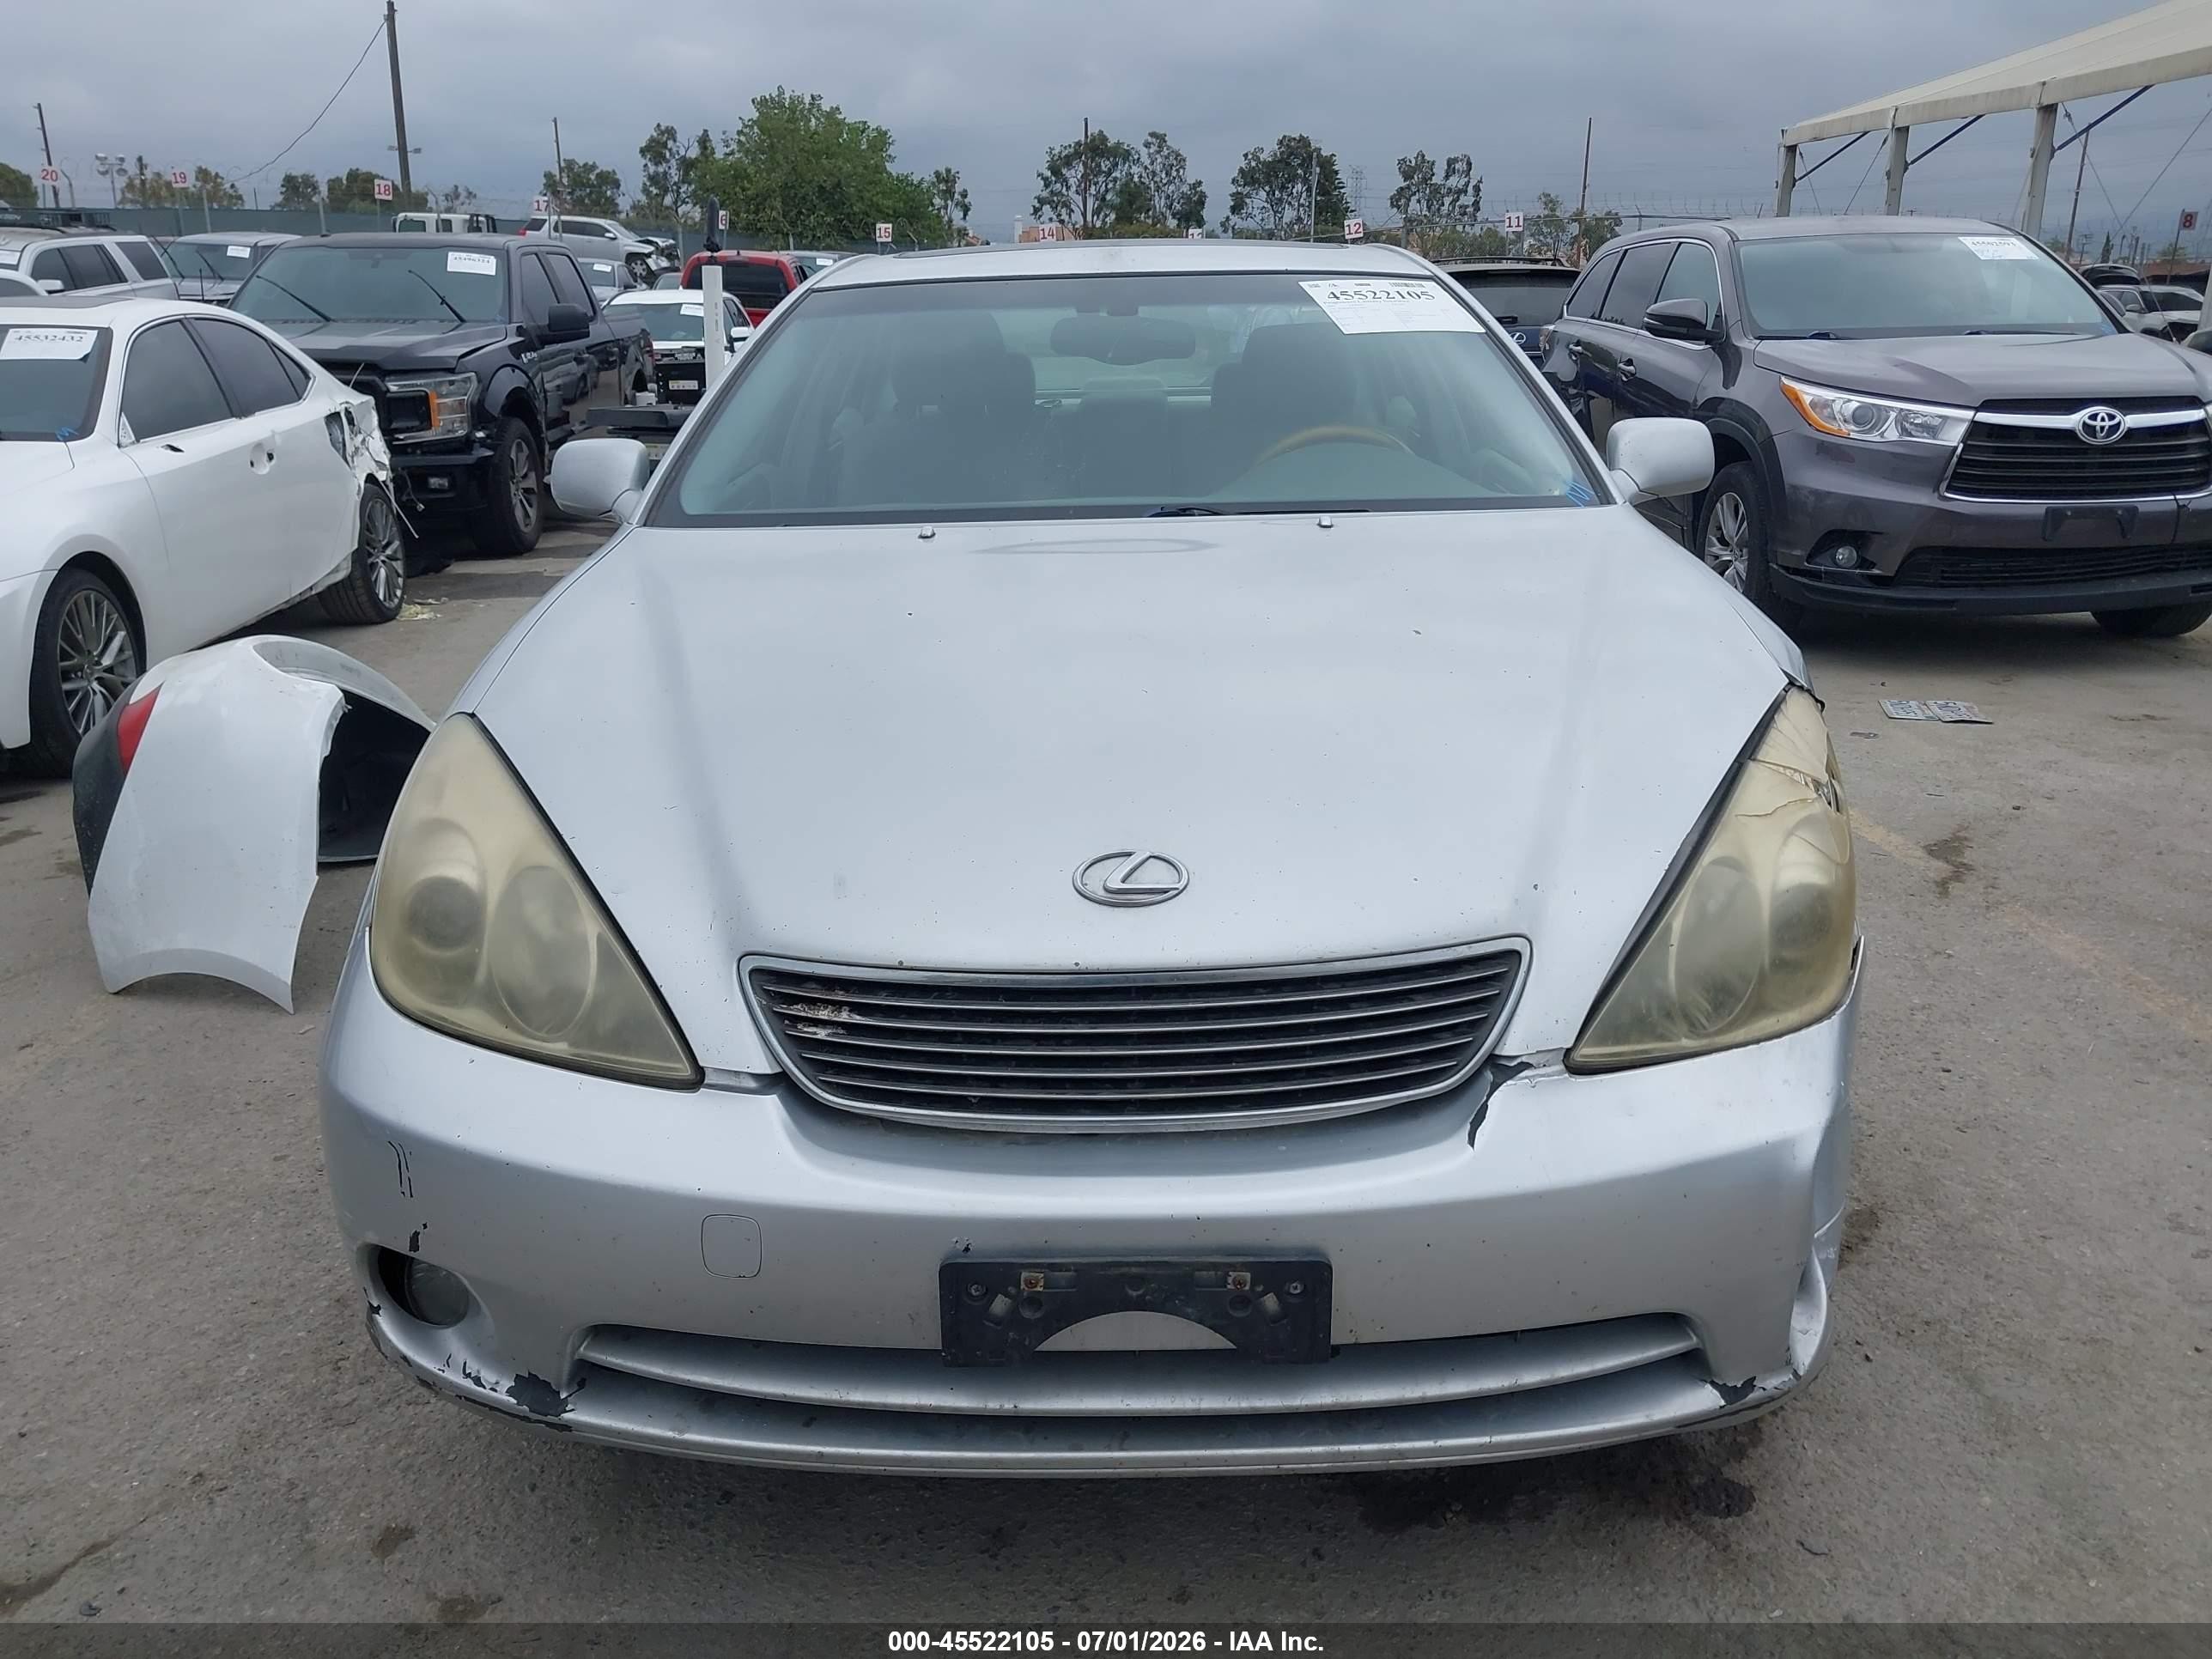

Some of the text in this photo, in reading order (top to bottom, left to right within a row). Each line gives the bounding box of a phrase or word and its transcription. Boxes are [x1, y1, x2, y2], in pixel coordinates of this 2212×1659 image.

[40, 168, 58, 182] 20
[172, 172, 186, 184] 19
[376, 183, 392, 197] 18
[534, 199, 550, 212] 17
[1507, 216, 1522, 228] 11
[2183, 214, 2193, 228] 8
[877, 226, 890, 239] 15
[1039, 228, 1055, 240] 14
[1346, 222, 1362, 236] 12
[1327, 290, 1436, 301] 45522105
